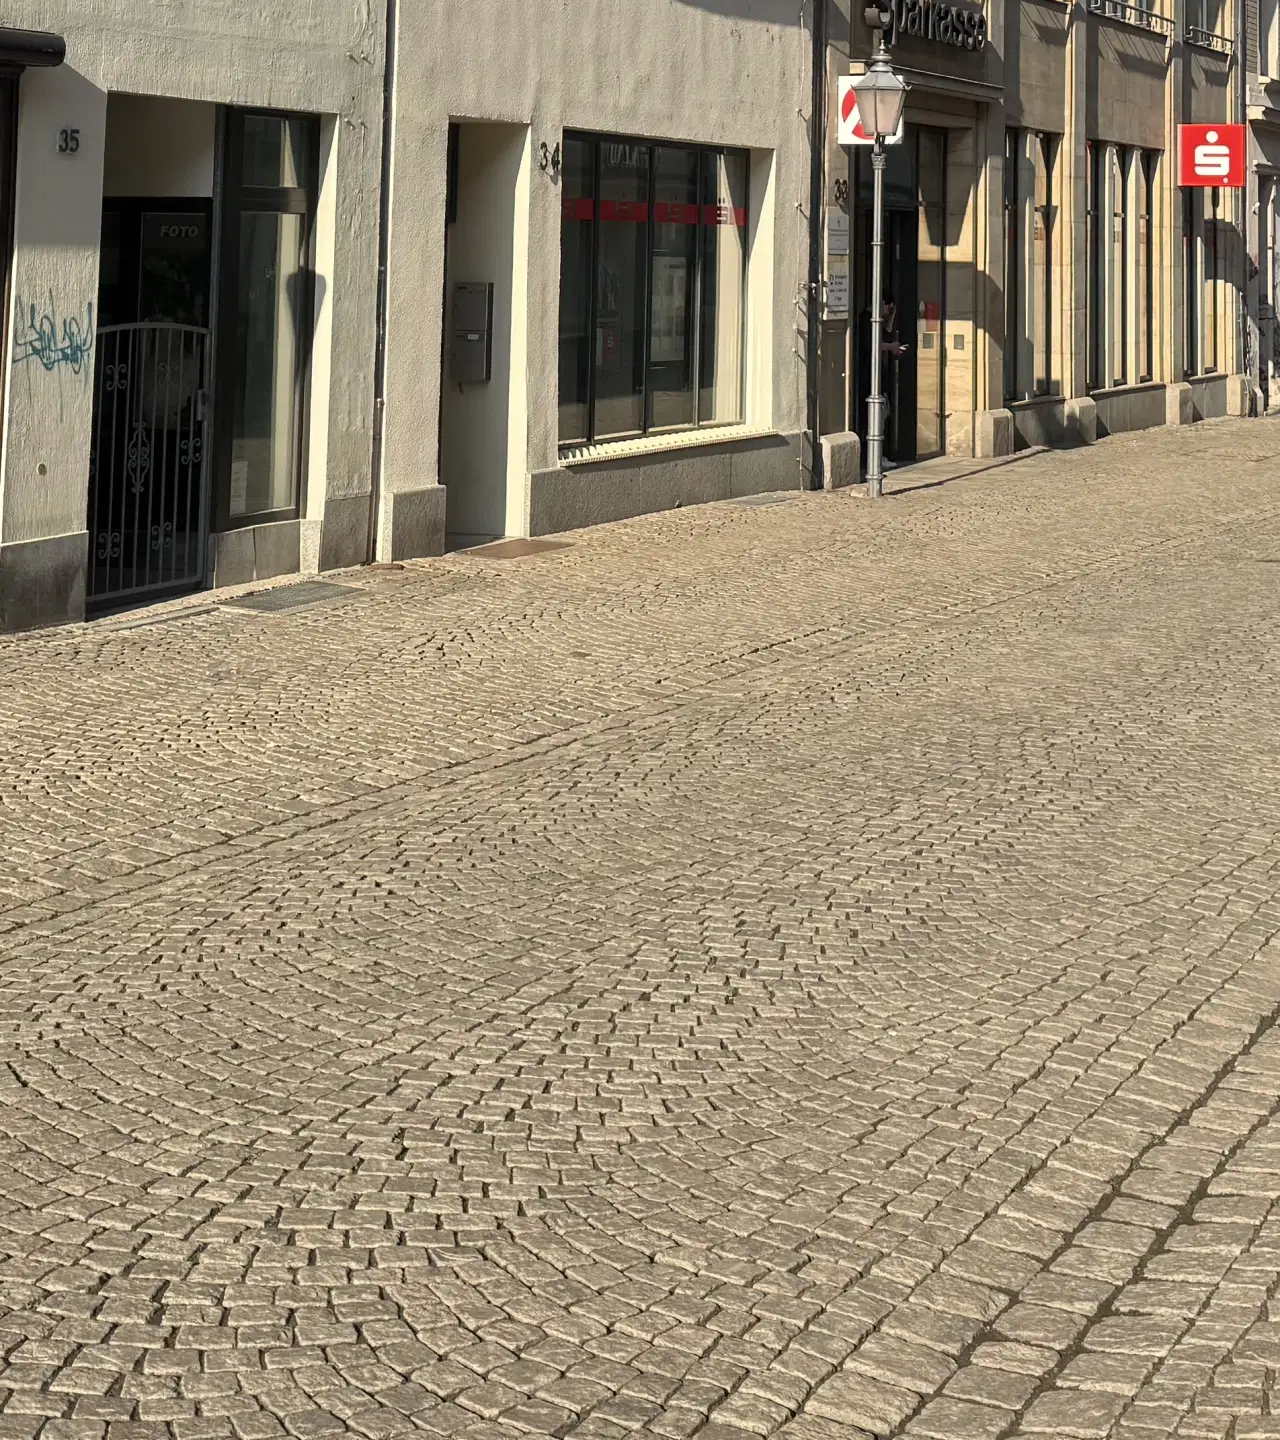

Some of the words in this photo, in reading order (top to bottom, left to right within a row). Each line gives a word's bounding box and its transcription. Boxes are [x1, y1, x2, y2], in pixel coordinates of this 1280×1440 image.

[57, 127, 81, 155] 35
[539, 141, 561, 172] 34
[159, 224, 200, 238] FOTO
